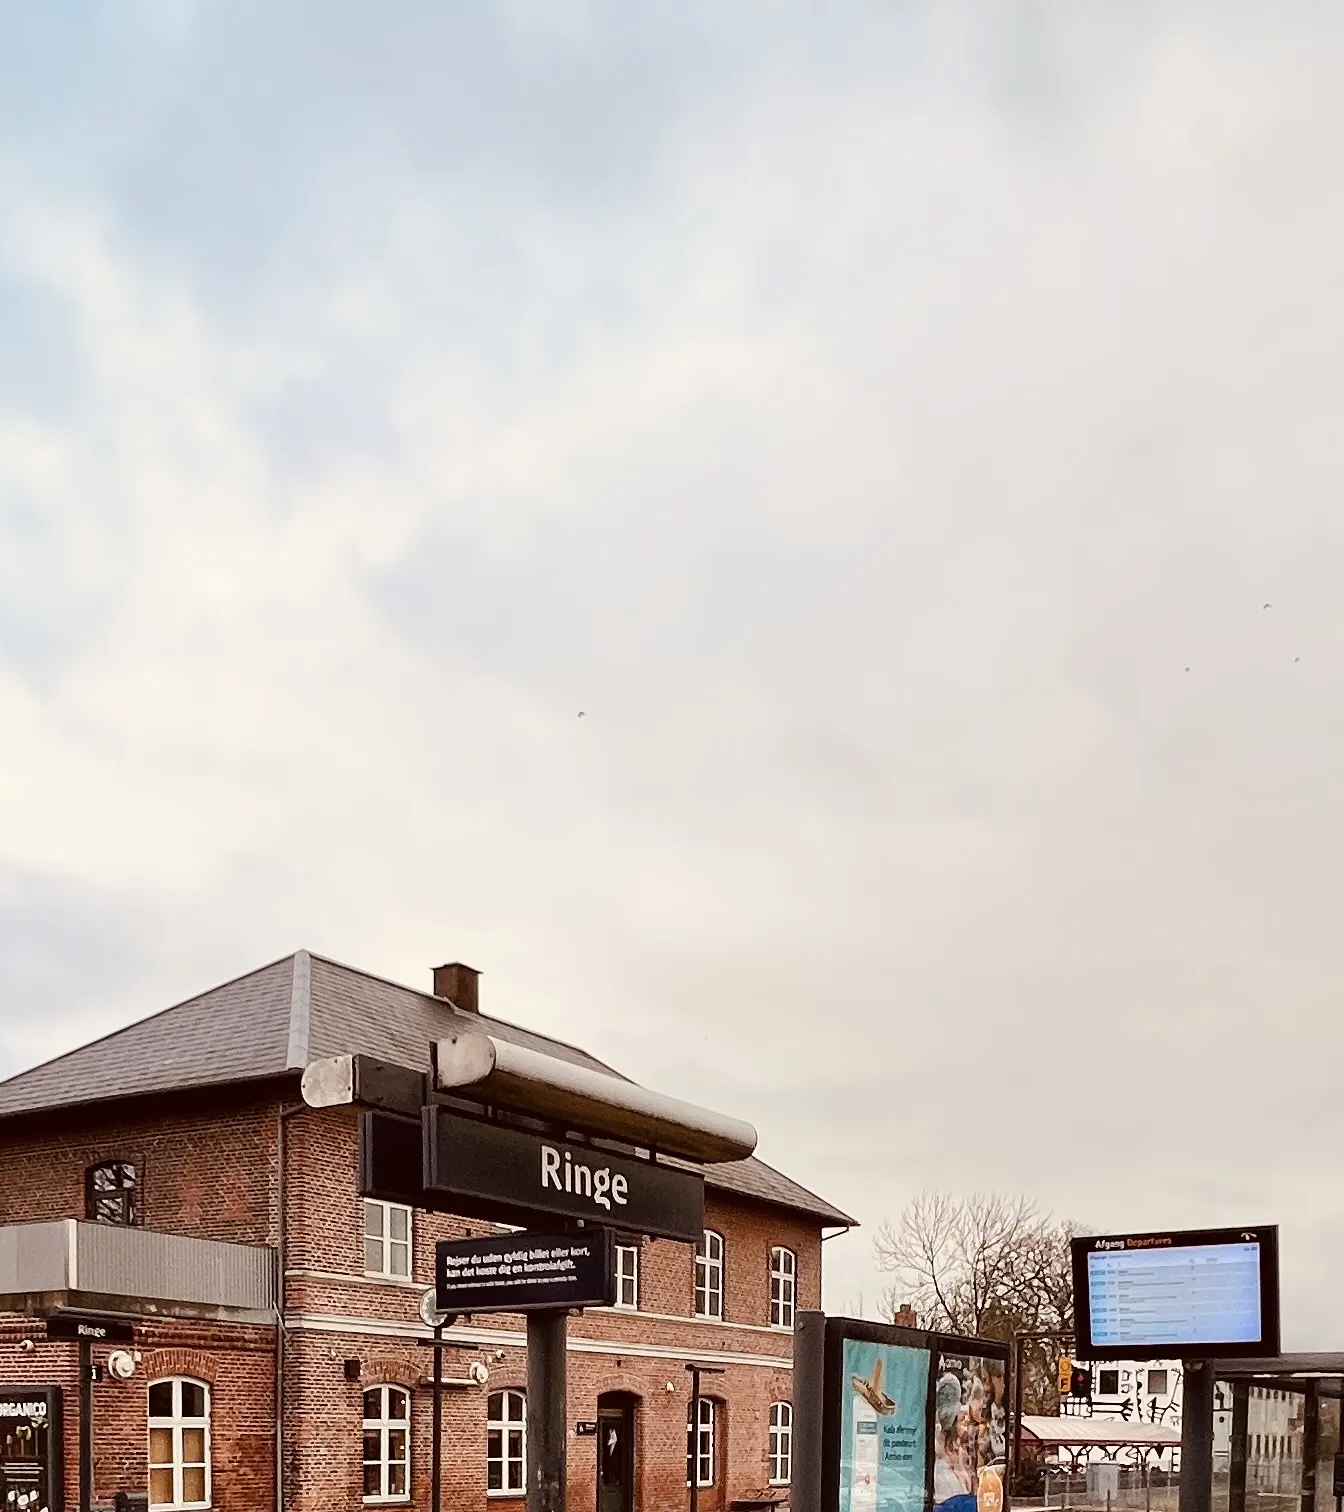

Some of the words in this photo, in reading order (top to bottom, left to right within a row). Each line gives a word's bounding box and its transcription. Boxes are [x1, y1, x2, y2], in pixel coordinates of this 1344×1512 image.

[541, 1145, 628, 1211] Ringe
[1095, 1240, 1125, 1250] Afgang
[1126, 1237, 1172, 1247] Departures
[471, 1254, 481, 1264] du
[482, 1252, 502, 1263] uden
[462, 1267, 474, 1277] det
[78, 1324, 106, 1338] Ringe
[1060, 1378, 1069, 1388] F
